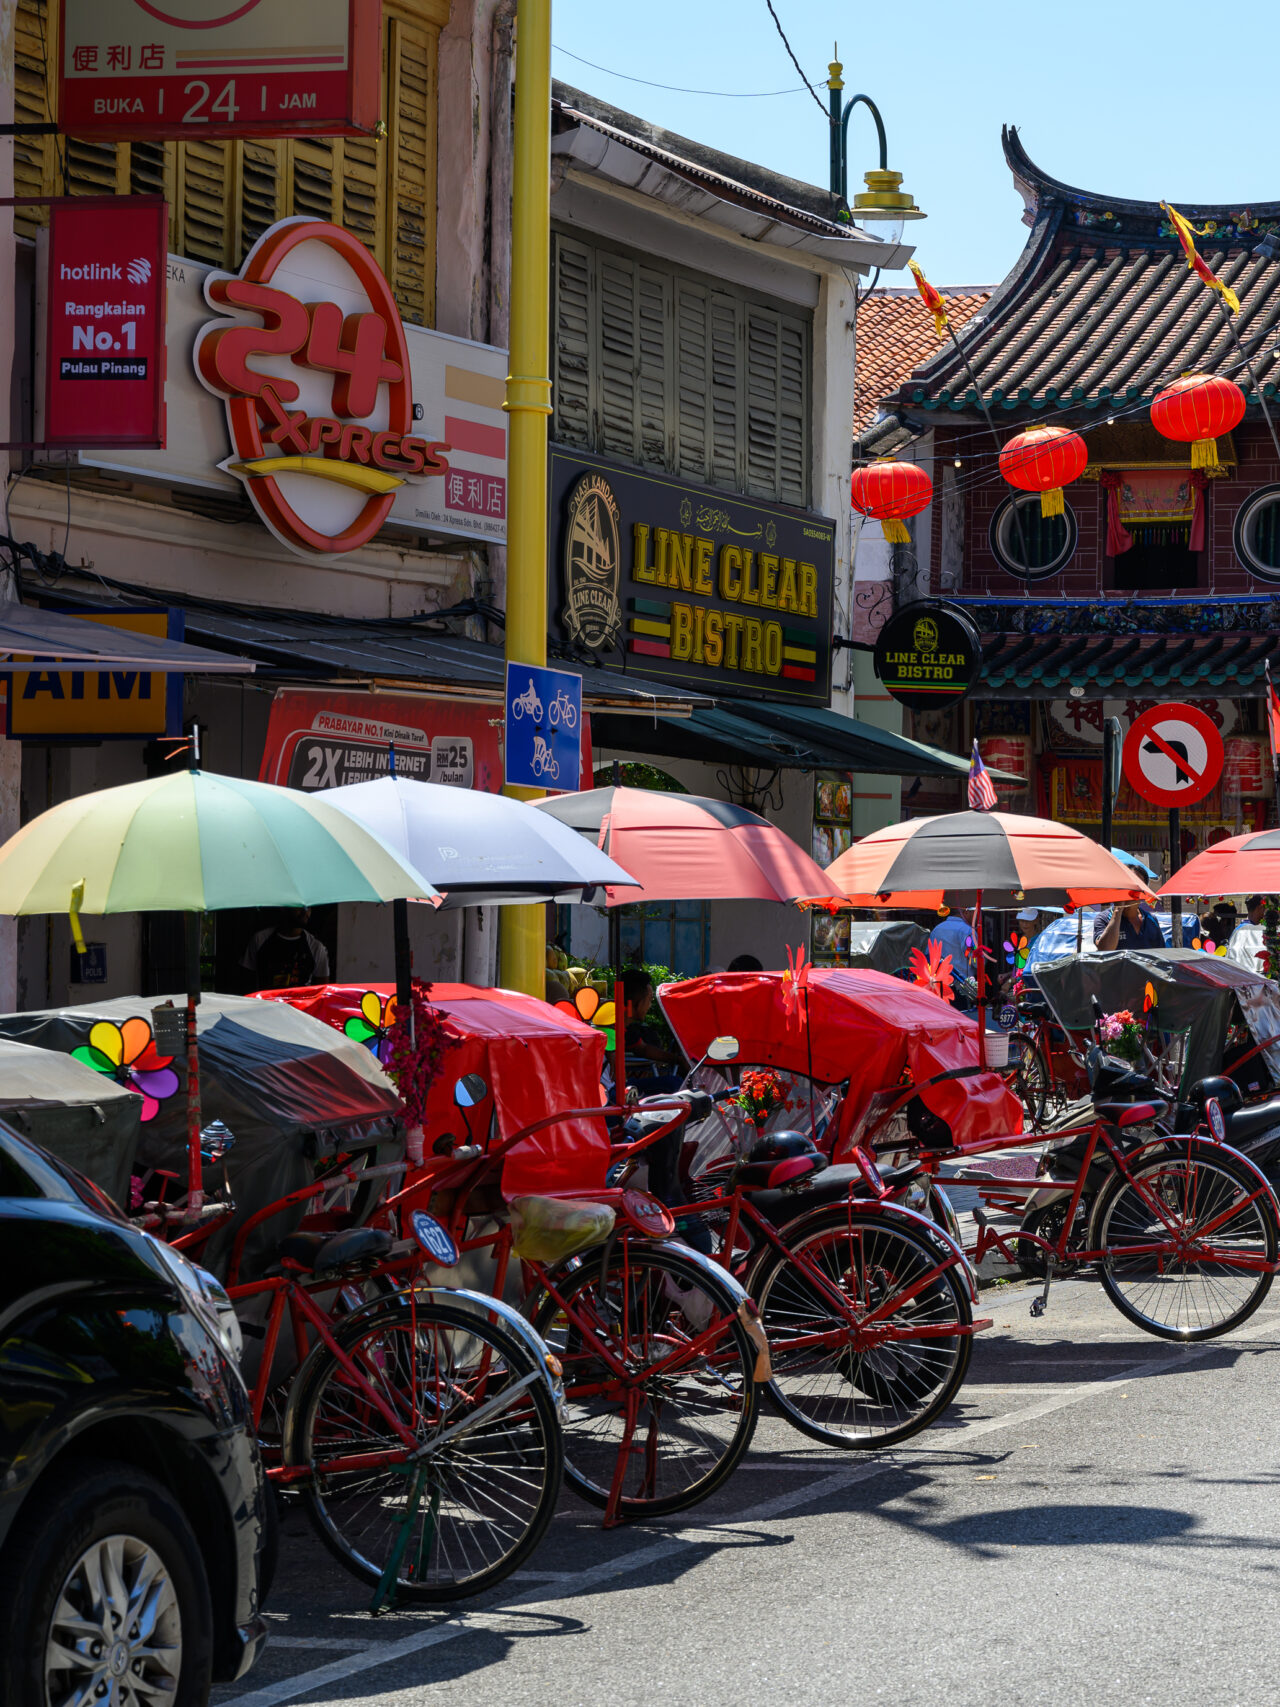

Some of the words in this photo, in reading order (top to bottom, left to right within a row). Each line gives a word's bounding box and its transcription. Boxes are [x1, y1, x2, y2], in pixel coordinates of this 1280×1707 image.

[72, 44, 165, 73] 便利店
[94, 97, 144, 115] BUKA
[181, 80, 240, 123] 24
[279, 93, 317, 109] JAM
[60, 263, 123, 281] hotlink
[65, 300, 146, 318] Rangkaian
[72, 321, 137, 351] No.1
[200, 280, 404, 420] 24
[61, 362, 98, 374] Pulau
[101, 362, 146, 376] Pinang
[261, 385, 452, 476] XPRESS
[448, 473, 503, 514] 便利店
[574, 477, 590, 506] NASI
[591, 474, 617, 515] KANDAR
[633, 521, 715, 597] LINE
[719, 544, 818, 619] CLEAR
[574, 589, 590, 609] LINE
[590, 589, 613, 615] CLEAR
[670, 601, 783, 677] BISTRO
[885, 651, 918, 663] LINE
[921, 653, 966, 665] CLEAR
[897, 665, 953, 679] BISTRO
[22, 656, 151, 700] ATM
[318, 716, 364, 736] PRABAYAR
[364, 724, 383, 738] NO.1
[384, 728, 395, 739] Kini
[411, 733, 425, 743] Taraf
[302, 746, 343, 788] 2X
[344, 750, 373, 769] LEBIH
[437, 755, 448, 768] RM
[449, 746, 467, 768] 25
[440, 771, 464, 784] /bulan
[86, 967, 102, 977] POLIS
[419, 1226, 453, 1256] 1627
